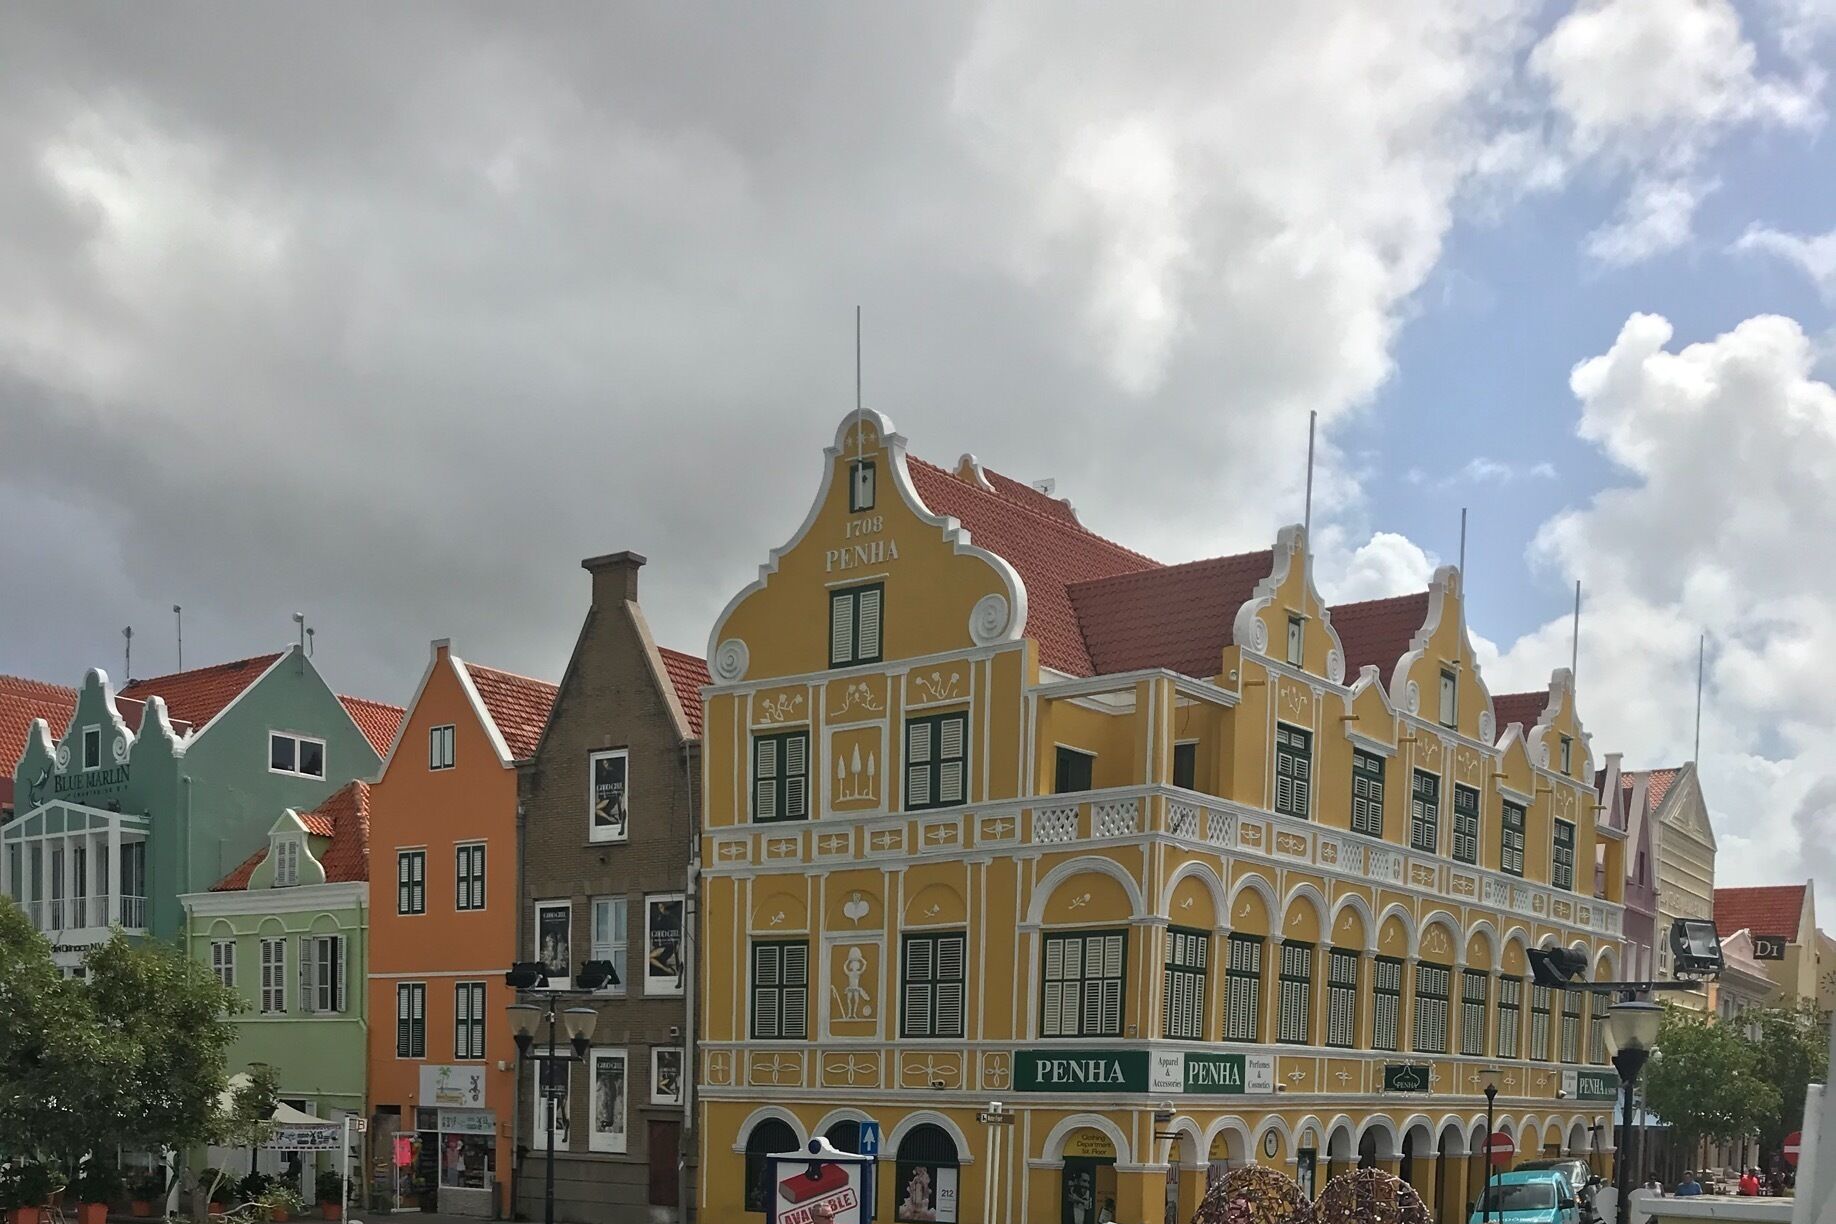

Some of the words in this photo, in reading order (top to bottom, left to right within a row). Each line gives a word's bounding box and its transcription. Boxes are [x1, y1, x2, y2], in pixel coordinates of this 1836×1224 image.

[845, 515, 884, 539] 1708
[825, 538, 899, 573] PENHA
[54, 774, 84, 793] BLUE
[86, 764, 130, 788] MARLIN
[1036, 1059, 1126, 1083] PENHA
[1159, 1057, 1179, 1067] Apparel
[1165, 1068, 1171, 1076] &
[1188, 1061, 1241, 1085] PENHA
[1153, 1079, 1182, 1088] Accessories
[1248, 1081, 1271, 1089] Cosmetics
[1579, 1077, 1604, 1095] PENHA
[941, 1189, 954, 1197] 212
